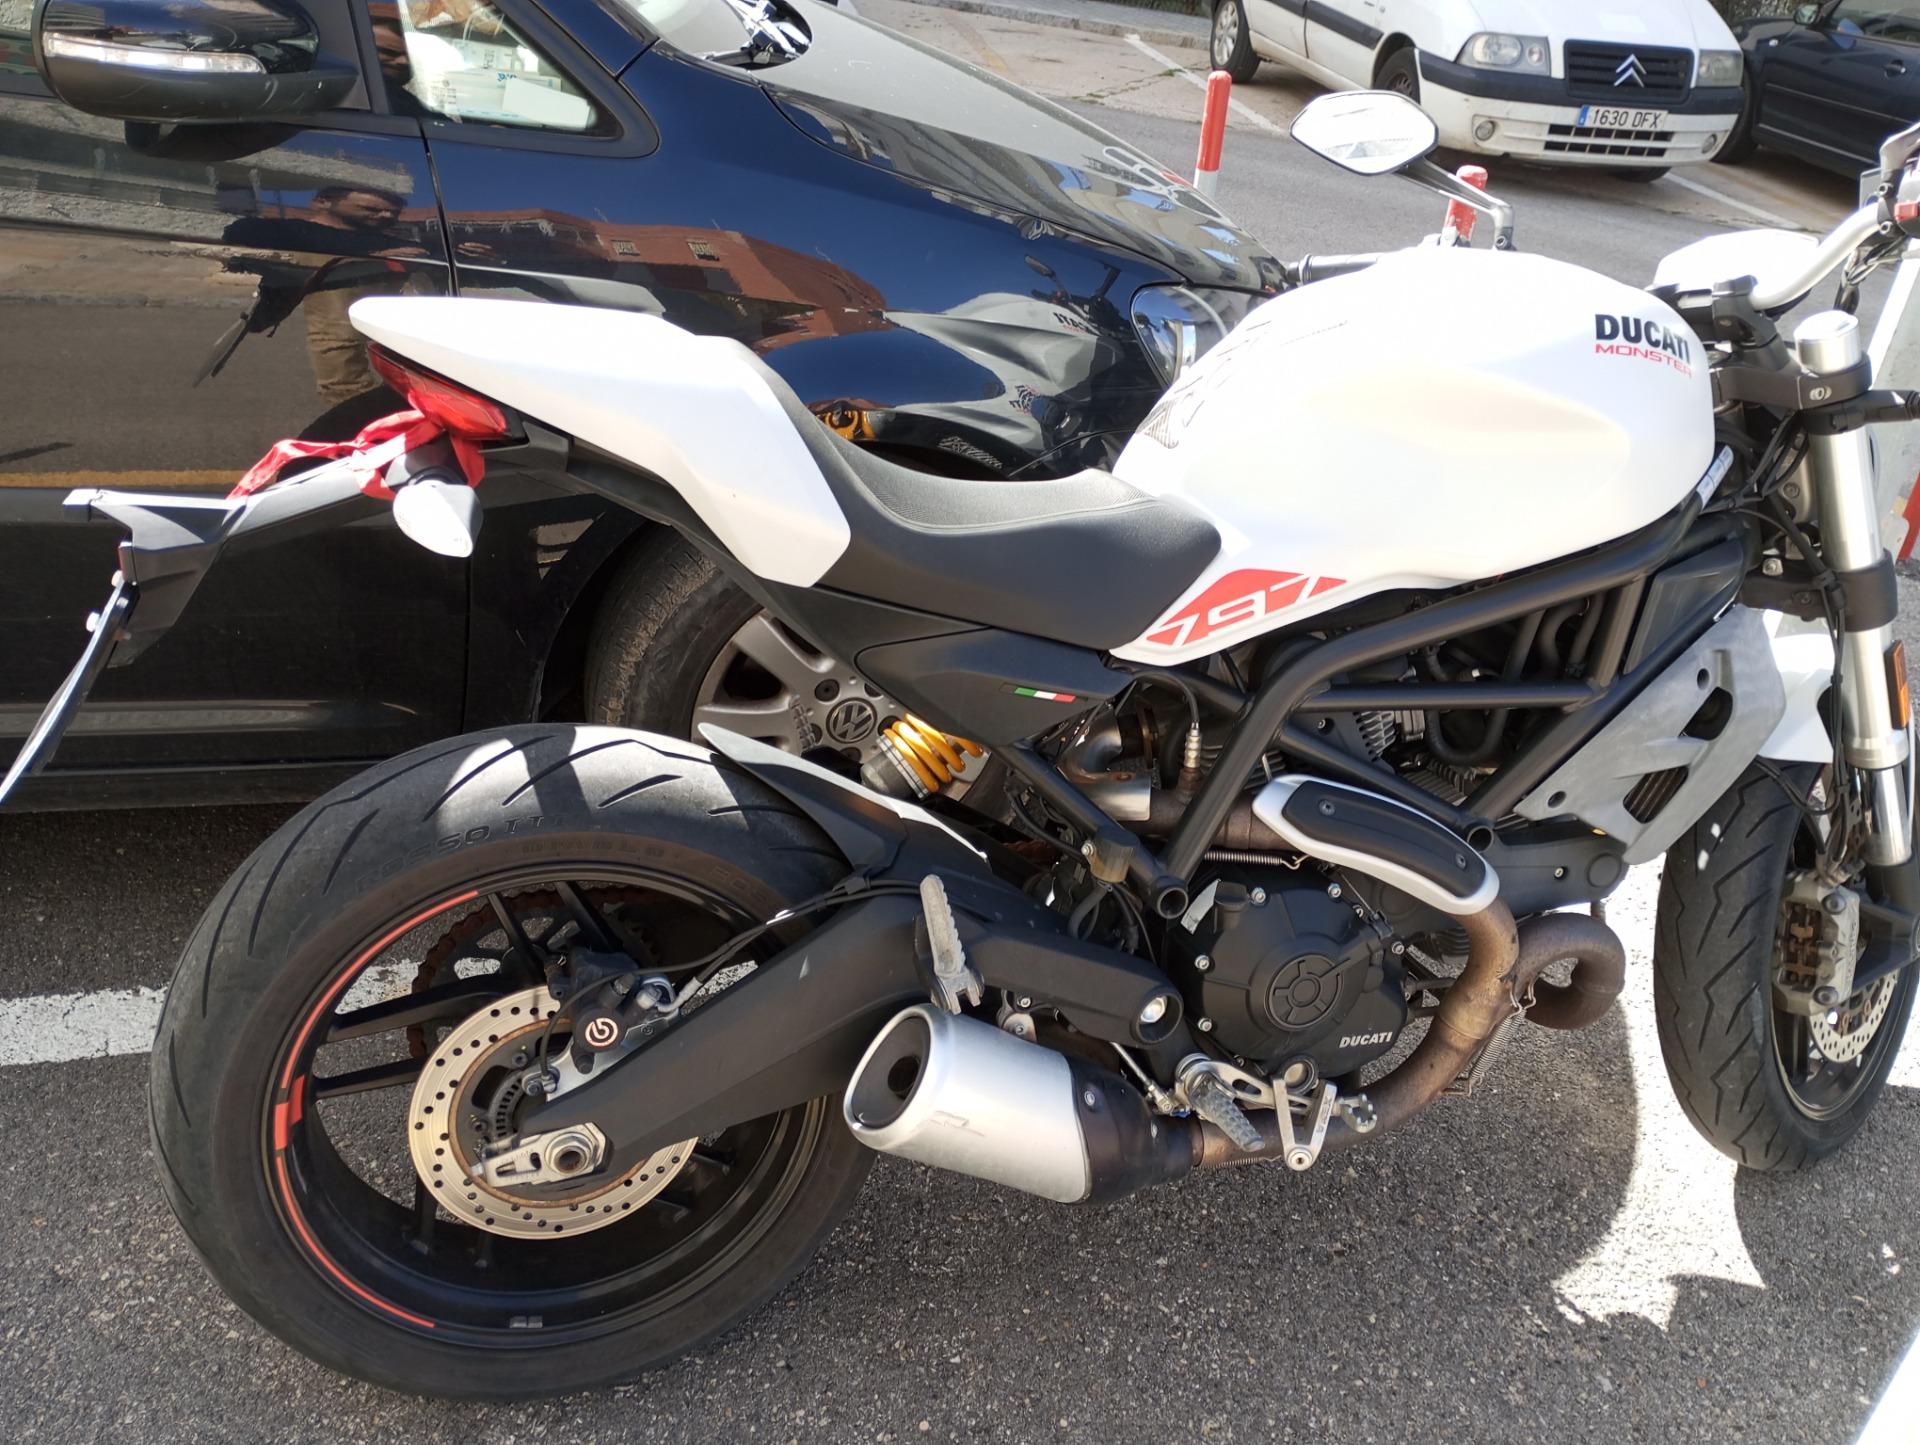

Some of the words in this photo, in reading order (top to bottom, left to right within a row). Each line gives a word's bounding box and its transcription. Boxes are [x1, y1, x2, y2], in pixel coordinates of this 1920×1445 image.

[1593, 109, 1629, 127] 1630
[1631, 111, 1662, 129] DFX
[1595, 314, 1692, 365] DUCATI
[1595, 343, 1692, 379] MONSTER
[1148, 573, 1325, 647] 797
[1339, 1031, 1393, 1049] DUCATI
